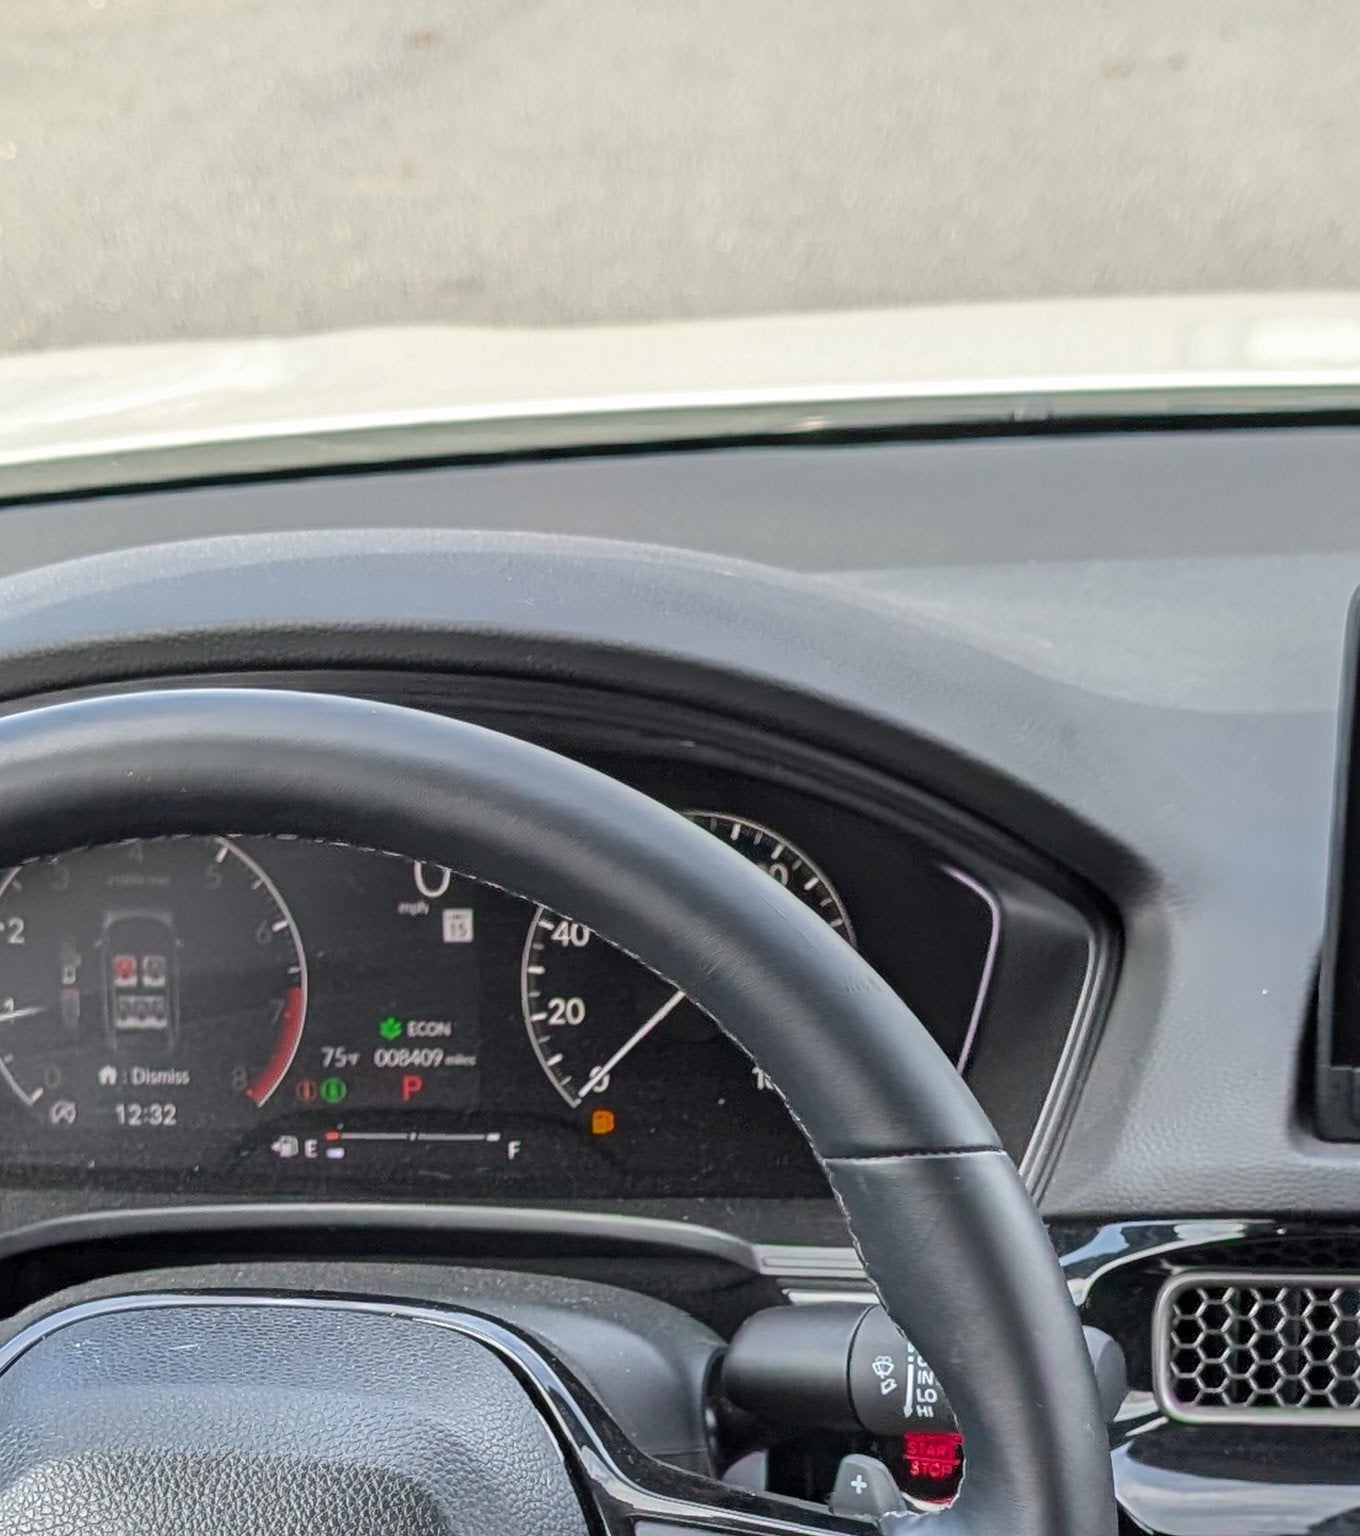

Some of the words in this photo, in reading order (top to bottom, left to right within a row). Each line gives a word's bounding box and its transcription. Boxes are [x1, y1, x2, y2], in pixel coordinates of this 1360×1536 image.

[7, 916, 26, 944] 2
[551, 920, 590, 948] 40
[547, 997, 586, 1026] 20
[407, 1020, 452, 1038] ECON
[373, 1047, 444, 1068] 008409
[131, 1066, 191, 1086] Dismiss
[402, 1074, 424, 1102] P
[114, 1103, 178, 1127] 12:32
[304, 1138, 318, 1159] E
[507, 1140, 522, 1160] F
[916, 1387, 938, 1403] LO
[916, 1405, 935, 1418] HI
